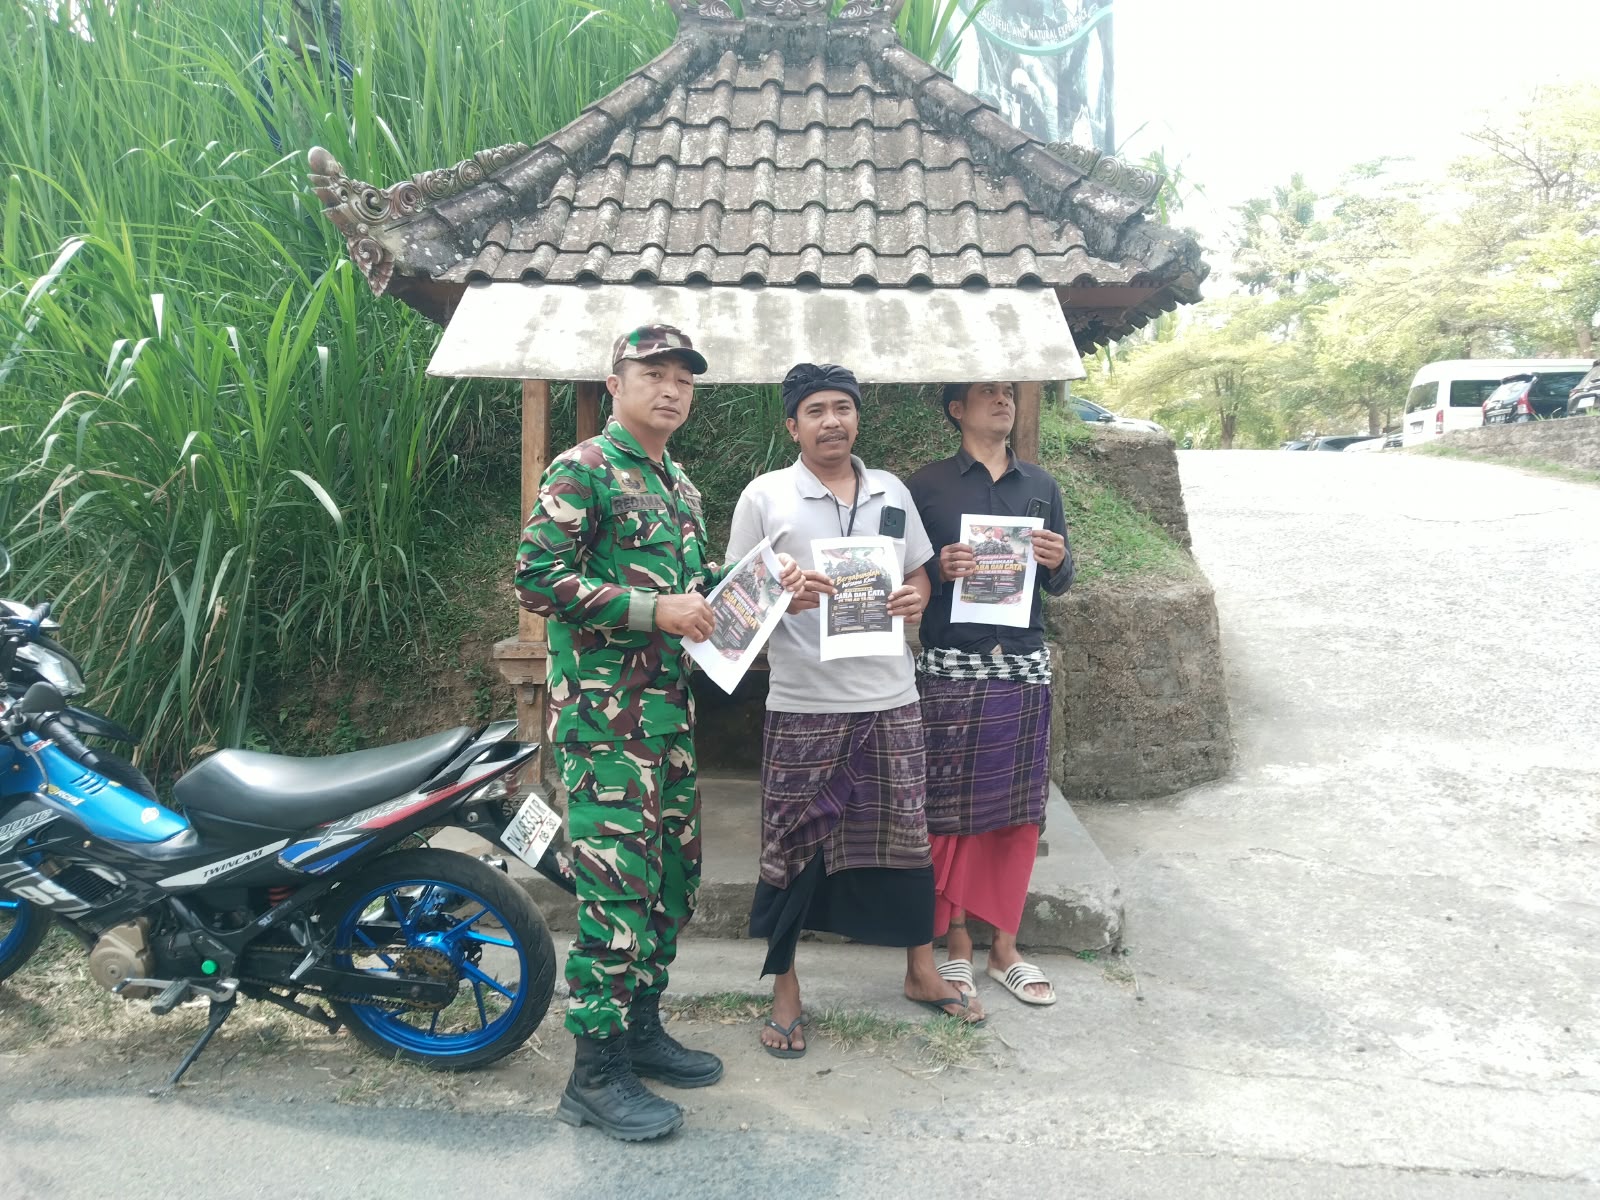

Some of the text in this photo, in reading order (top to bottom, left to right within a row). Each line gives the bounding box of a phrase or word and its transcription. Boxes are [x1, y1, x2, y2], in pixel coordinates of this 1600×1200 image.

[1013, 28, 1027, 39] AND
[1028, 27, 1058, 40] NATURAL
[507, 830, 525, 852] DK
[202, 849, 264, 878] TWINCAM
